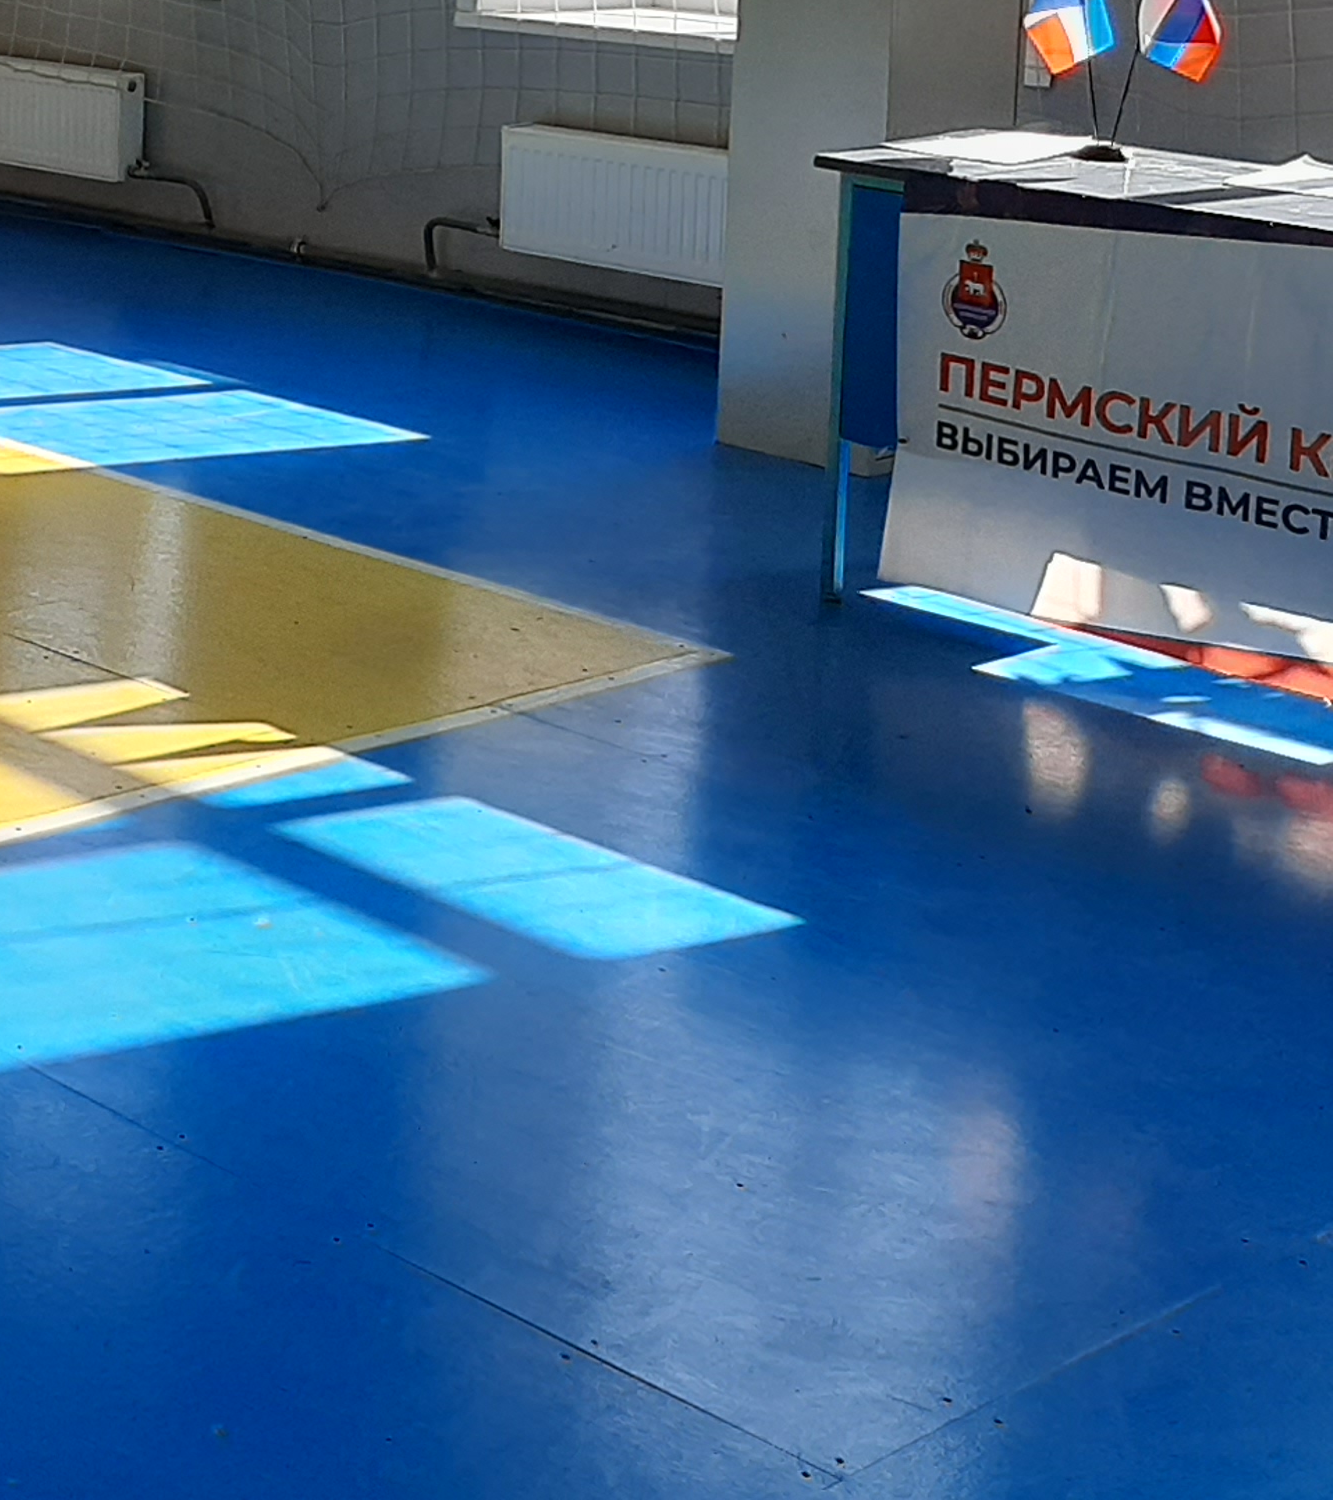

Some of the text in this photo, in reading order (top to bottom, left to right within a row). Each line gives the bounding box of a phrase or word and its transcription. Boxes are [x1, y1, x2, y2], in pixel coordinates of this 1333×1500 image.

[935, 420, 1169, 504] ВЫБИРАЕМ
[939, 352, 1333, 477] ПЕРМСКИЙ К
